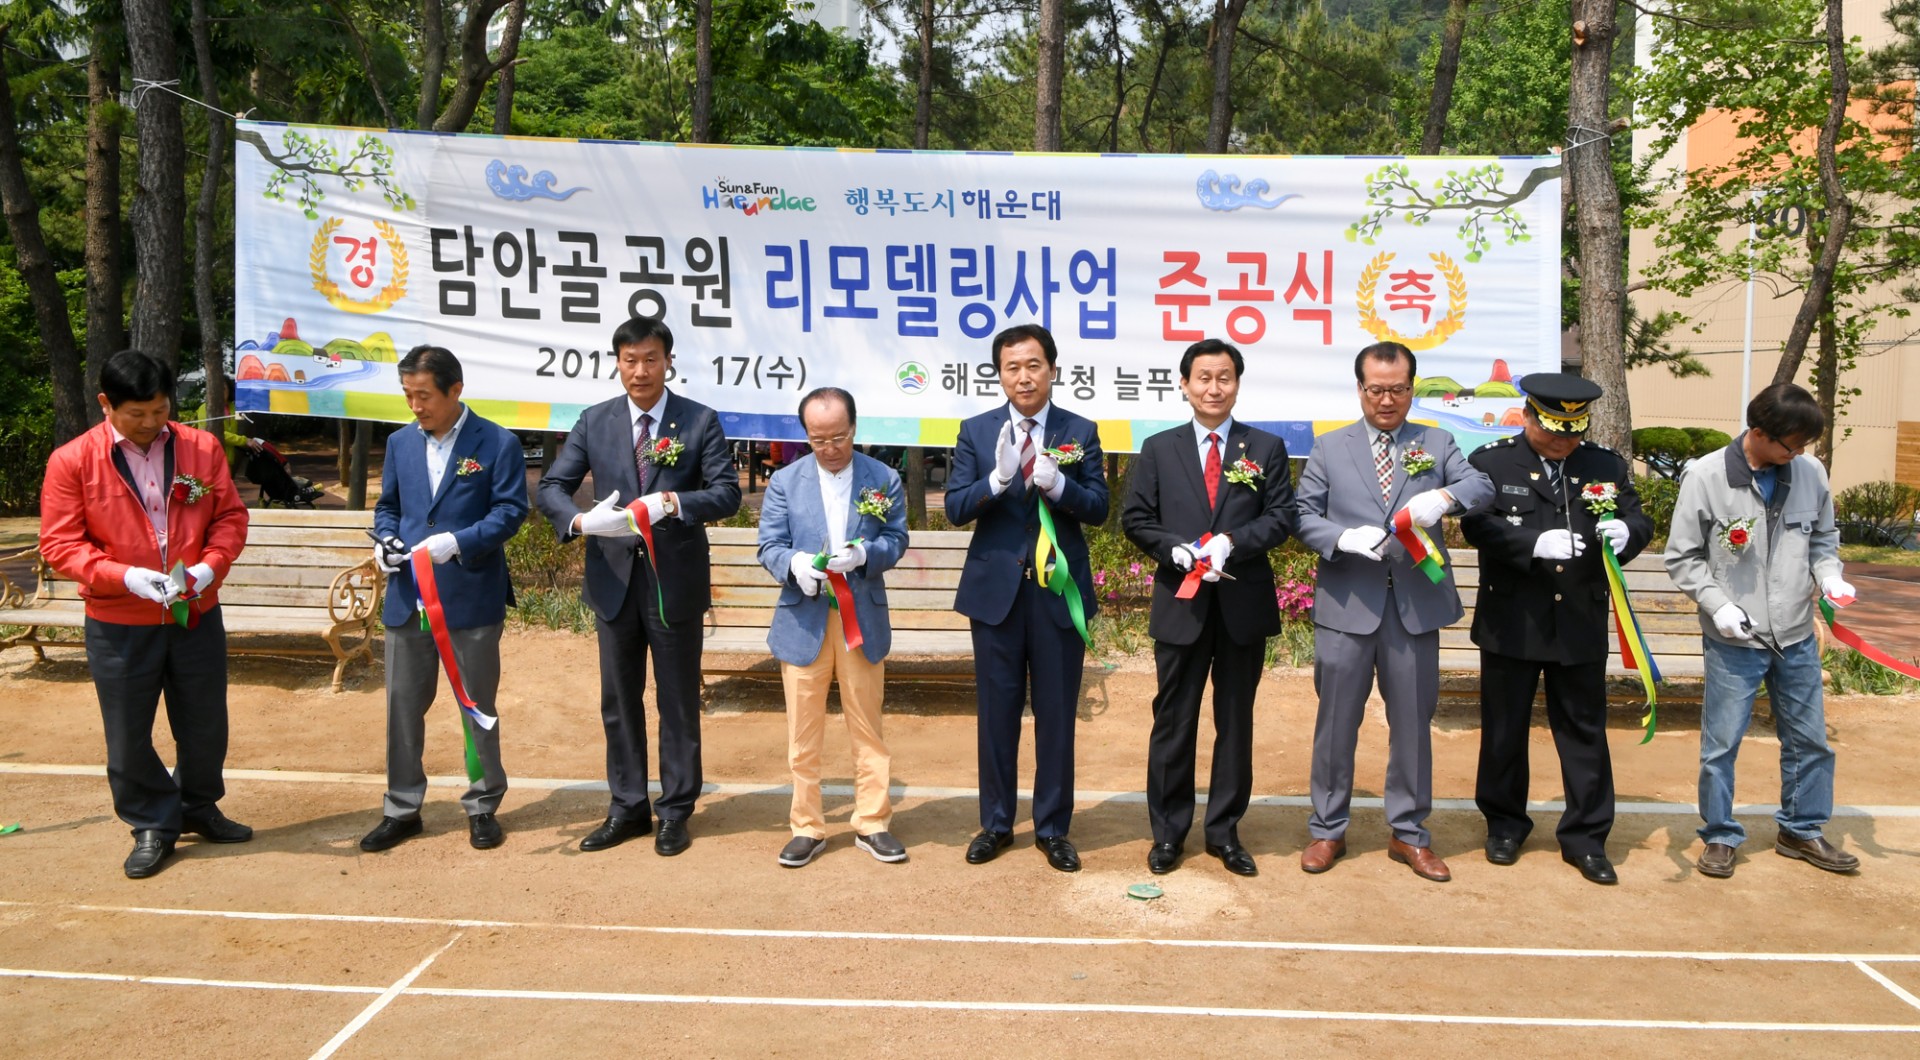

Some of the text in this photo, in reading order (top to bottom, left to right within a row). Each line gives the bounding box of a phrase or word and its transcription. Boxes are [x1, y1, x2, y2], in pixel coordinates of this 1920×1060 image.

[702, 185, 817, 216] Haeundae
[719, 181, 778, 195] Sun&Fun
[844, 187, 1061, 220] 행복도시 해운대
[333, 235, 377, 289] 경
[430, 225, 1334, 346] 담안골공원 리모델링사업 준공식
[1384, 268, 1437, 324] 축
[712, 355, 807, 391] 17(수)
[941, 361, 1190, 402] 해운구청 늘푸
